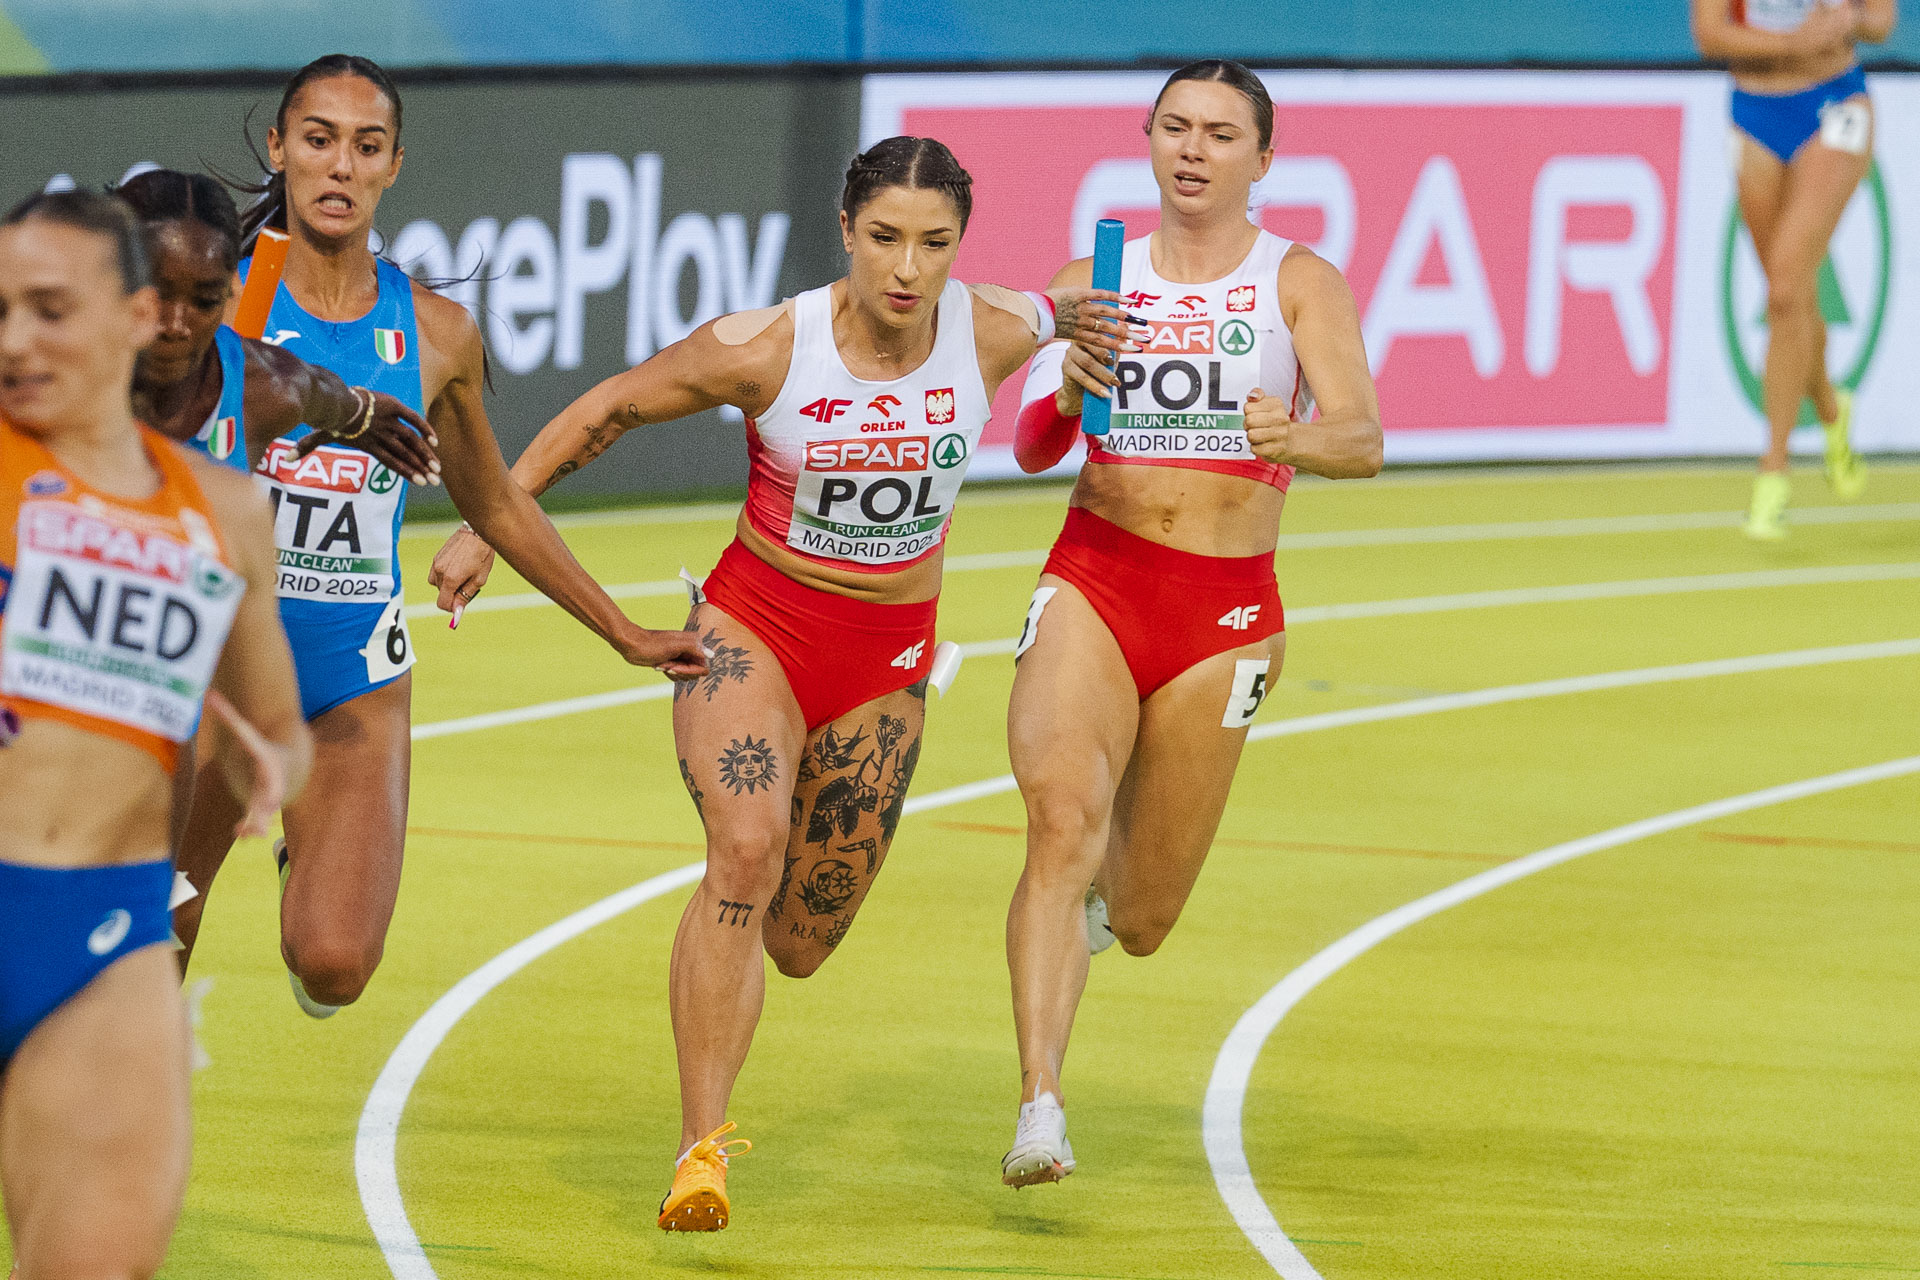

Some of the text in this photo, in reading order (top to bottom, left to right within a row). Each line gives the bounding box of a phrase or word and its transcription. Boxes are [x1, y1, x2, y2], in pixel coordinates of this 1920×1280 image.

[1116, 359, 1238, 411] POL
[799, 397, 854, 424] 4F
[1127, 415, 1132, 427] I
[1134, 415, 1164, 427] RUN
[860, 420, 906, 433] ORLEN
[809, 440, 925, 468] SPAR
[1108, 434, 1244, 452] MADRID 2025
[817, 476, 940, 524] POL
[802, 530, 890, 558] MADRID
[835, 524, 870, 537] RUN
[275, 572, 379, 596] RID 2025
[38, 565, 199, 661] NED
[1217, 603, 1262, 631] 4F
[385, 608, 407, 666] 6
[890, 638, 926, 671] 4F
[1242, 673, 1267, 719] 5
[718, 898, 755, 929] 777
